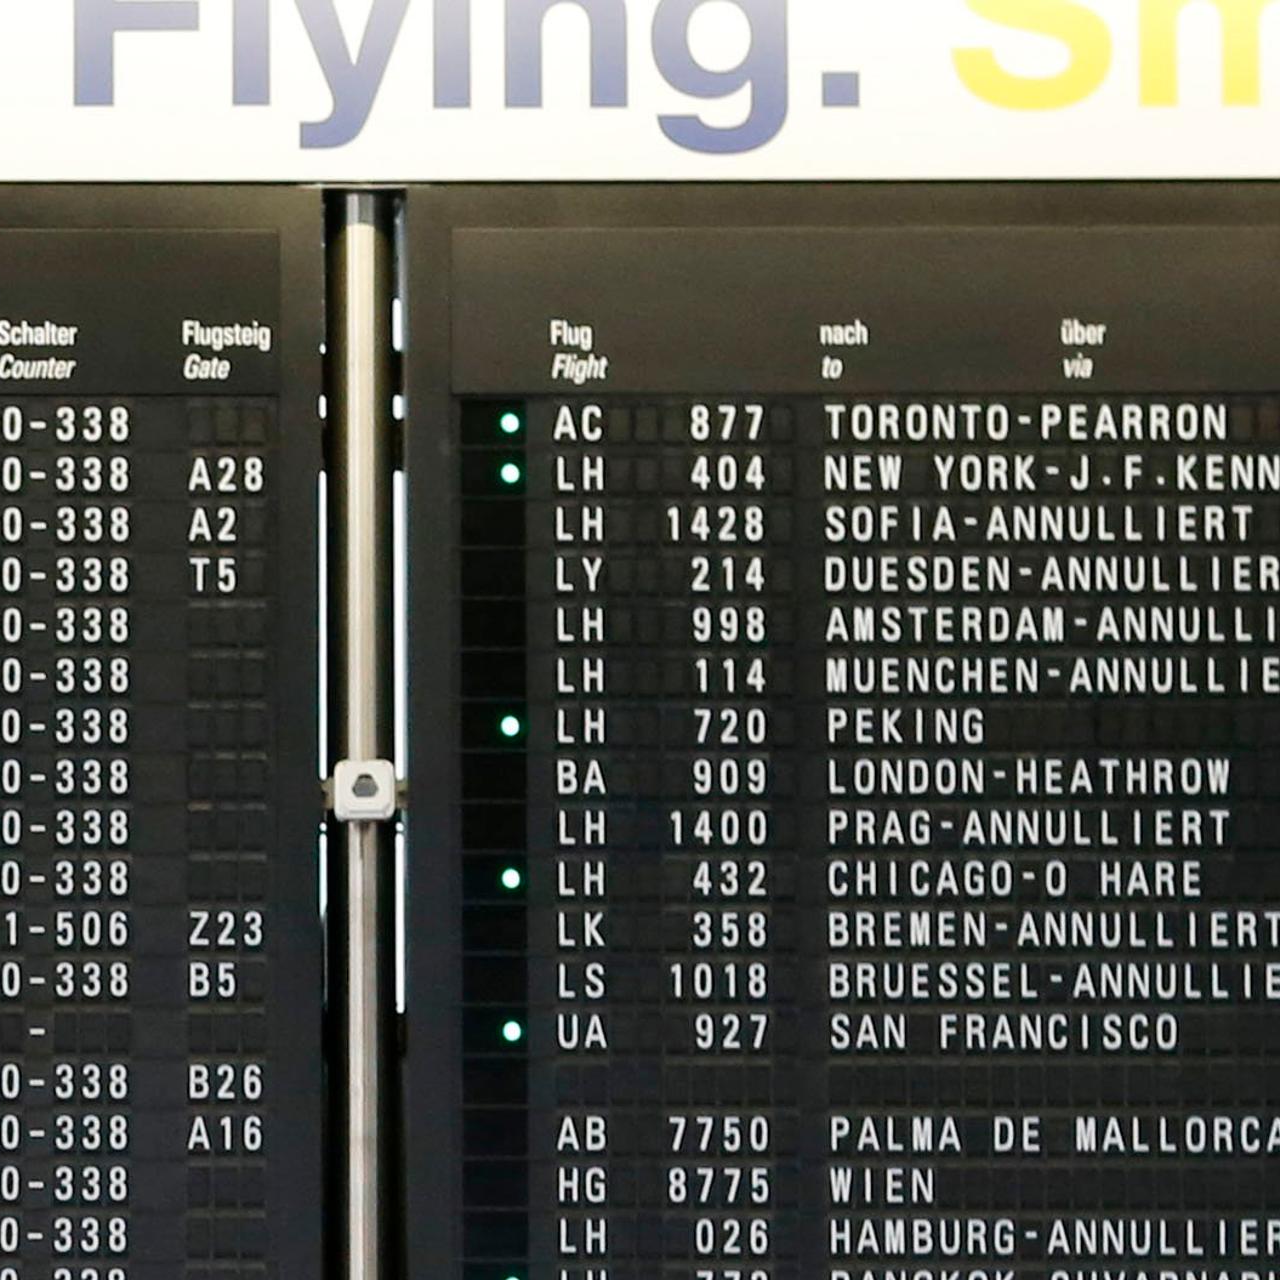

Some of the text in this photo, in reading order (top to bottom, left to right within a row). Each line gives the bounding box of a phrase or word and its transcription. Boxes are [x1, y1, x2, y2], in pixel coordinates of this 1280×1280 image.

[182, 320, 272, 352] Flugsteig
[550, 319, 593, 351] Flug
[820, 318, 869, 346] nach
[1061, 318, 1107, 346] über
[184, 353, 231, 380] Gate
[551, 353, 609, 385] Flight
[822, 355, 843, 380] to
[1063, 352, 1094, 379] via
[825, 404, 1225, 440] TORONTO-PEARRON
[189, 457, 262, 491] A28
[825, 455, 901, 490] NEW
[826, 505, 1252, 541] SOFIA-ANNULLIERT
[829, 709, 982, 743] PEKING
[829, 759, 1229, 794] LONDON-HEATHROW
[830, 810, 1229, 845] PRAG-ANNULLIERT
[829, 860, 1200, 896] CHICAGO-O HARE
[190, 911, 261, 945] Z23
[831, 1014, 1176, 1049] SAN FRANCISCO
[190, 1065, 261, 1099] B26
[832, 1117, 960, 1151] PALMA
[995, 1117, 1039, 1151] DE
[831, 1168, 932, 1202] WIEN
